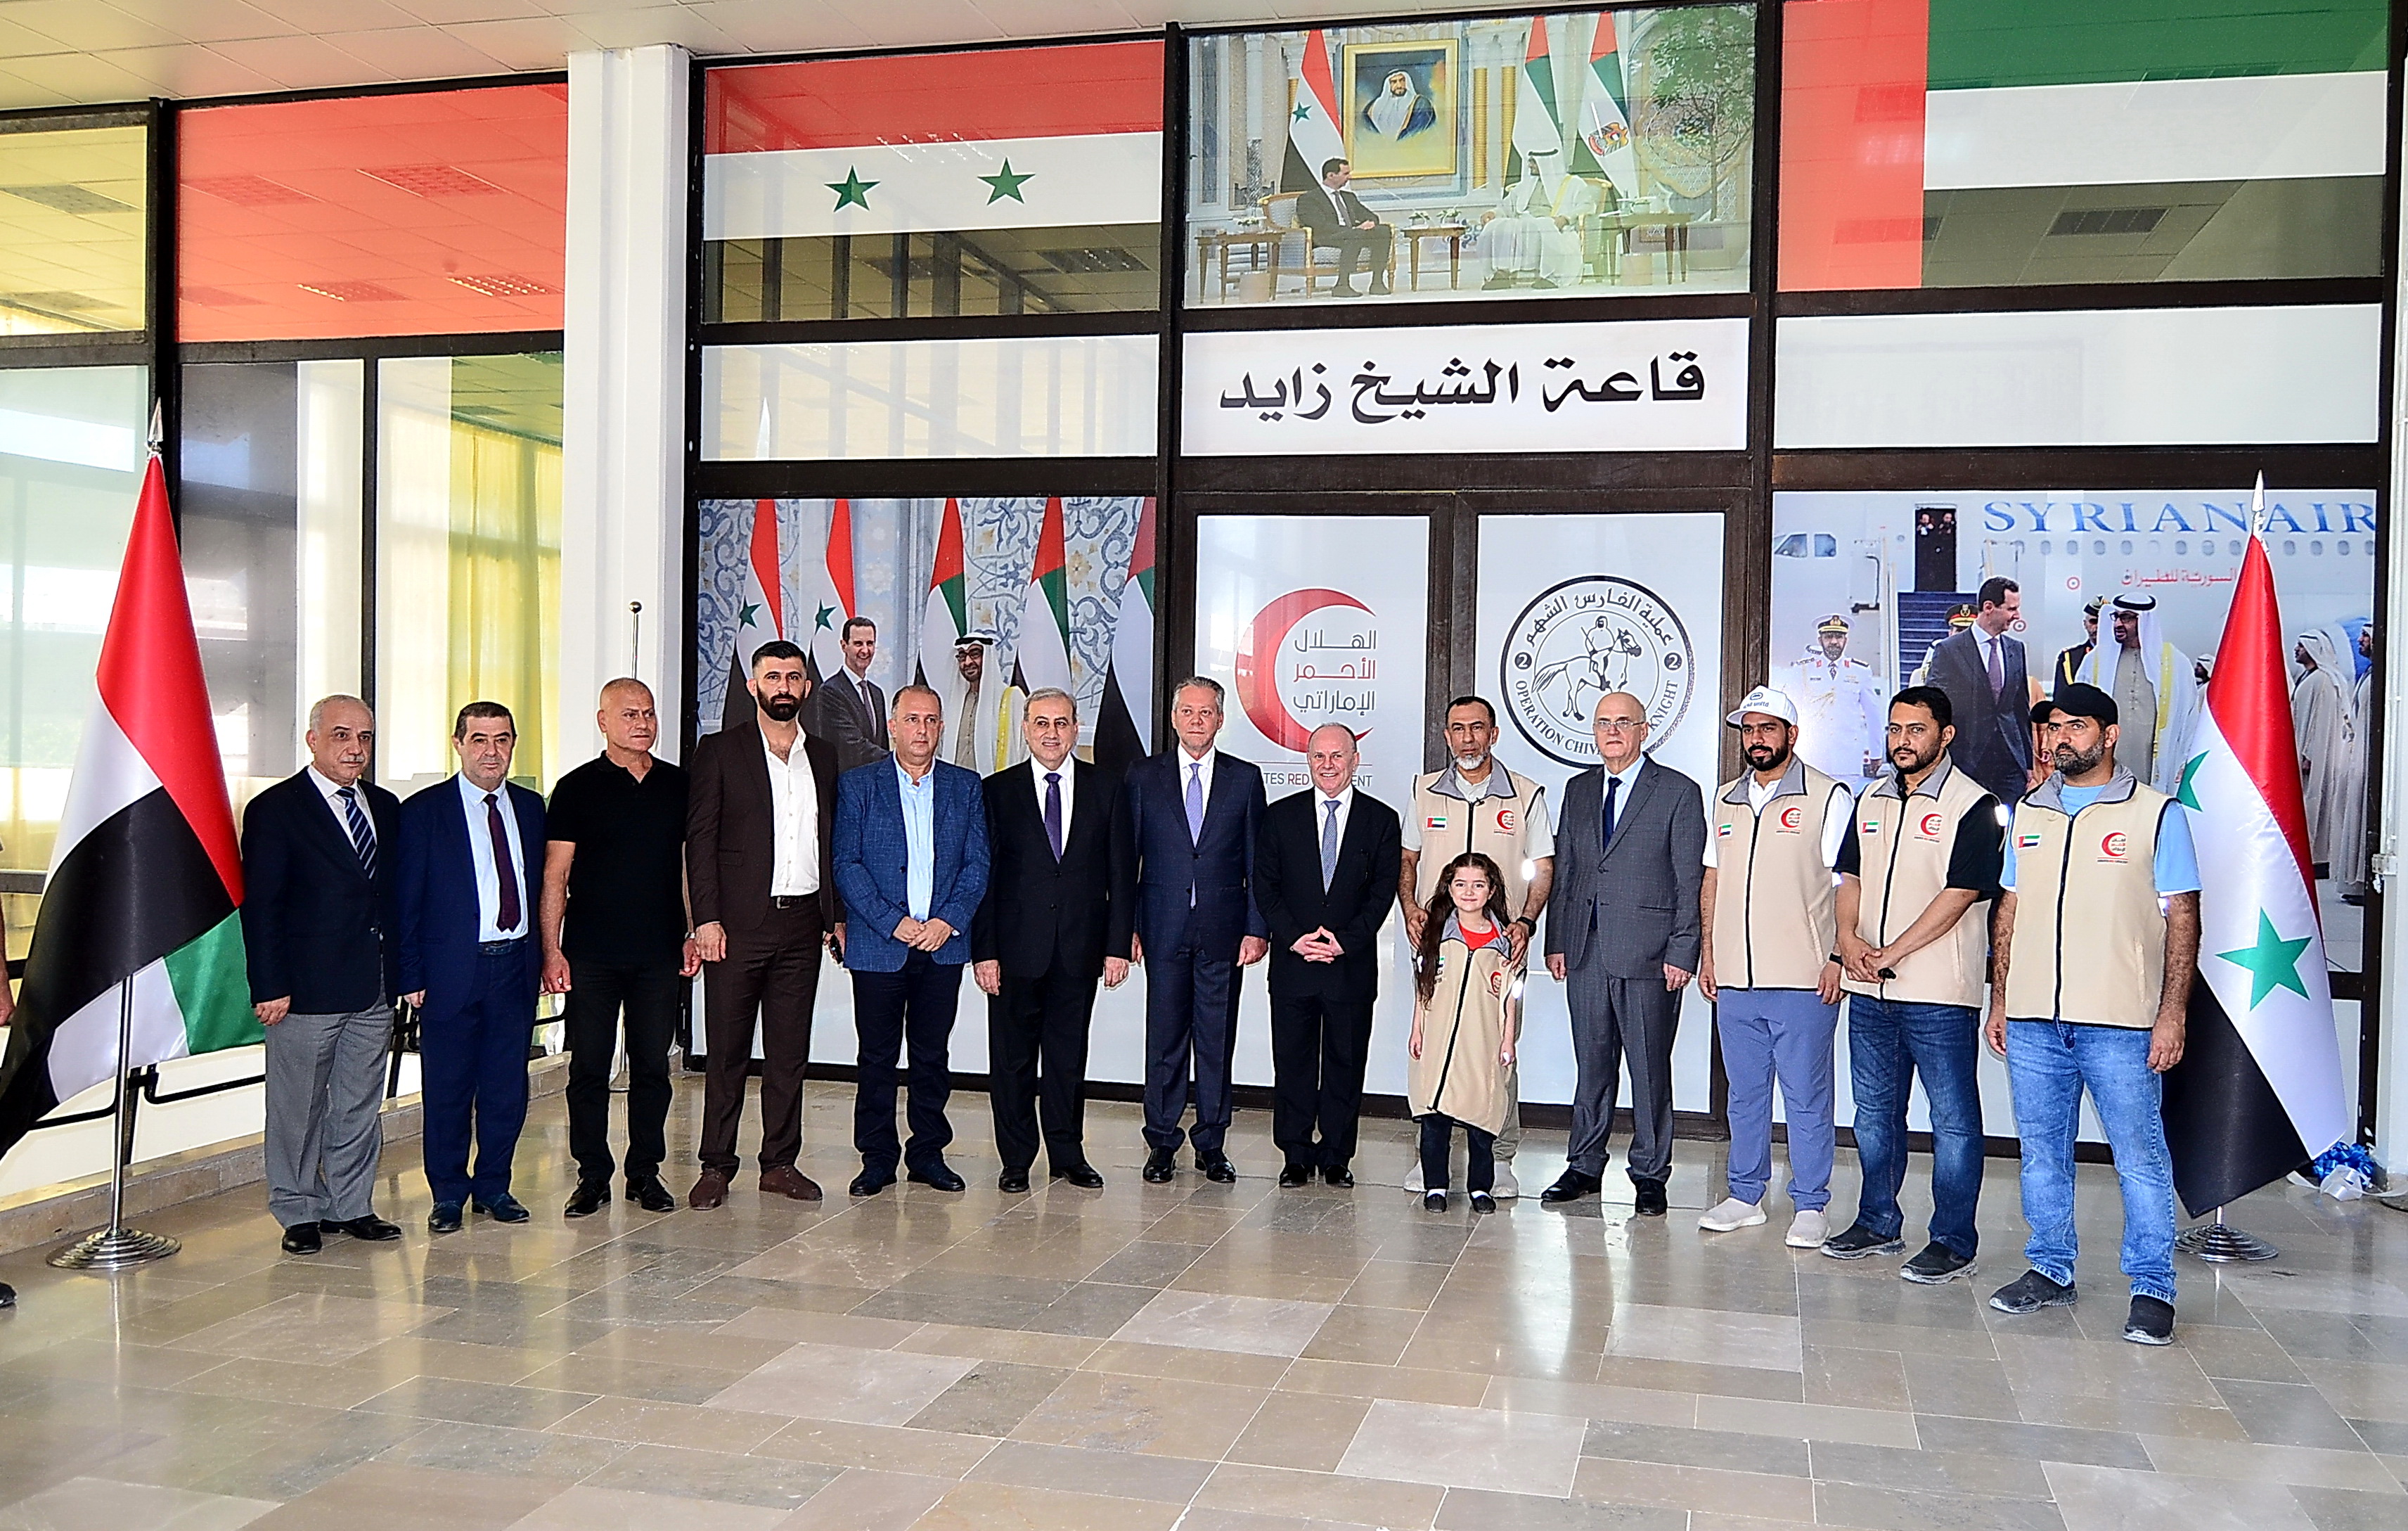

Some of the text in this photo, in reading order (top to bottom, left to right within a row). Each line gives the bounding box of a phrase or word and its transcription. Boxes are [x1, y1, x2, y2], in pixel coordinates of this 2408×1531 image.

[1220, 351, 1705, 423] قاعة الشيخ زايد
[1526, 588, 1674, 648] عملية الفارس الشهم
[1295, 629, 1376, 652] الهلال
[1293, 658, 1376, 682] الأحمر
[1518, 655, 1528, 668] 2
[1668, 655, 1679, 669] 2
[1293, 690, 1375, 716] الإماراتي
[1515, 679, 1564, 746] OPERATION
[1649, 680, 1678, 732] KNIGHT
[1287, 773, 1310, 786] RED
